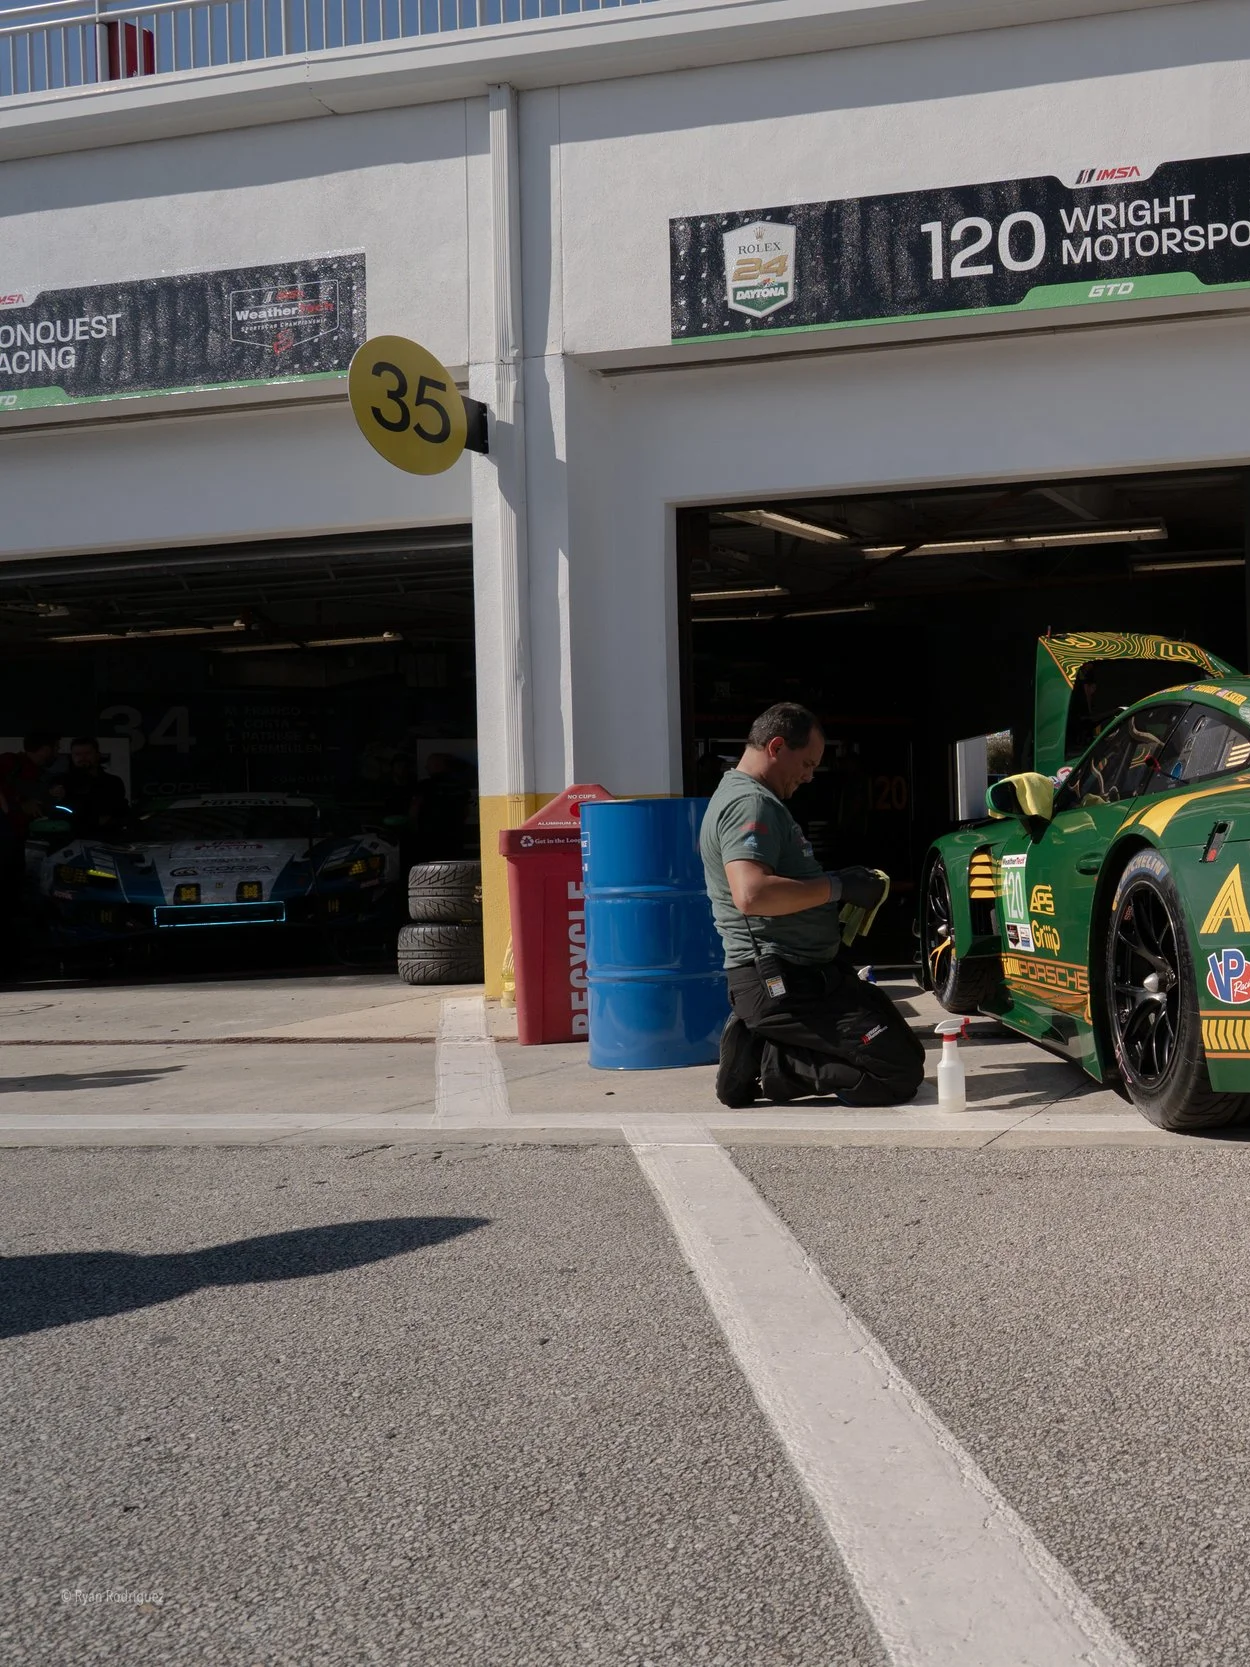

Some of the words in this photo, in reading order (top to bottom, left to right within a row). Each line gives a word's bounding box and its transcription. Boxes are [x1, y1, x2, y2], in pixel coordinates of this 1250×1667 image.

[1096, 166, 1140, 181] IMSA
[1060, 195, 1195, 234] WRIGHT
[738, 242, 781, 254] ROLEX
[920, 211, 1046, 280] 120
[732, 254, 788, 282] 24
[736, 287, 785, 300] DAYTONA
[1088, 282, 1134, 298] GTD
[370, 361, 451, 444] 35
[100, 705, 197, 754] 34
[1019, 959, 1089, 993] PORSCHE
[1207, 948, 1245, 1003] VP
